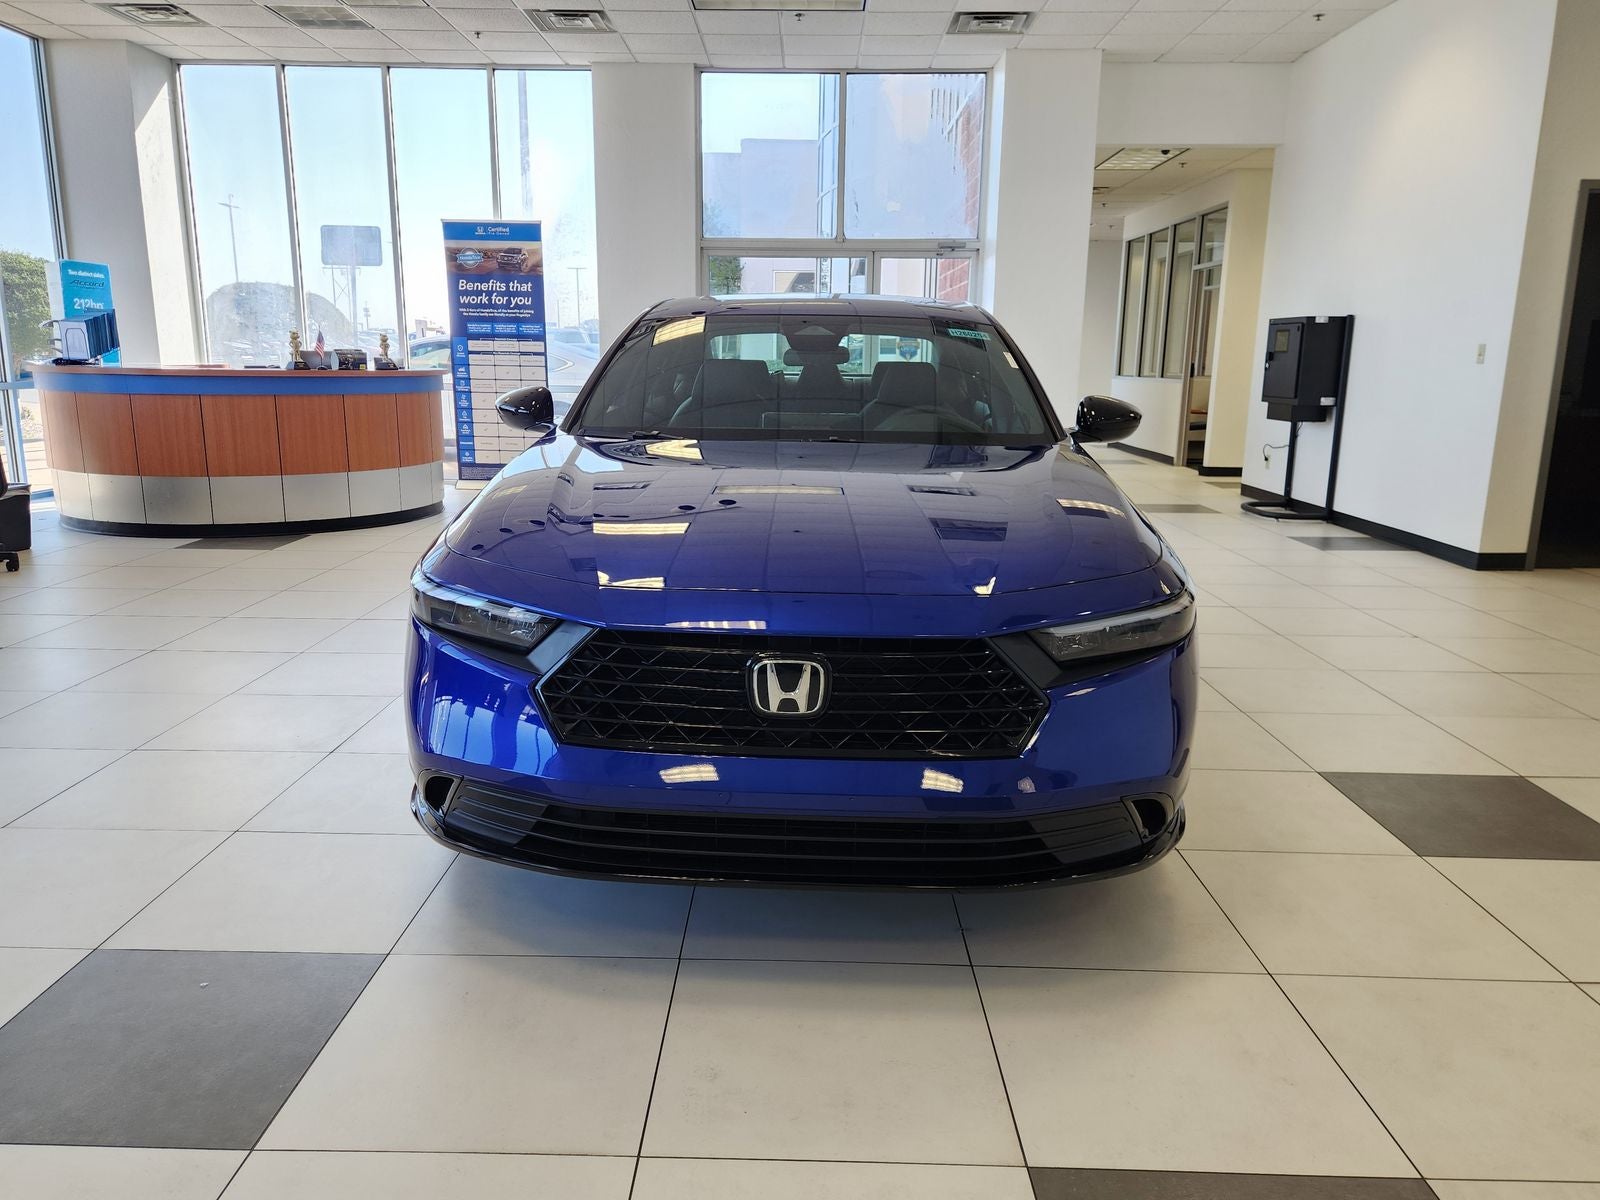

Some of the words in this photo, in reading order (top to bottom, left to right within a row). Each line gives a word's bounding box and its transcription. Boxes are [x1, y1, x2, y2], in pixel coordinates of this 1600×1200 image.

[70, 279, 105, 287] Accord
[458, 279, 506, 292] Benefits
[508, 280, 533, 292] that
[459, 292, 489, 304] work
[491, 293, 509, 305] for
[508, 296, 532, 308] you
